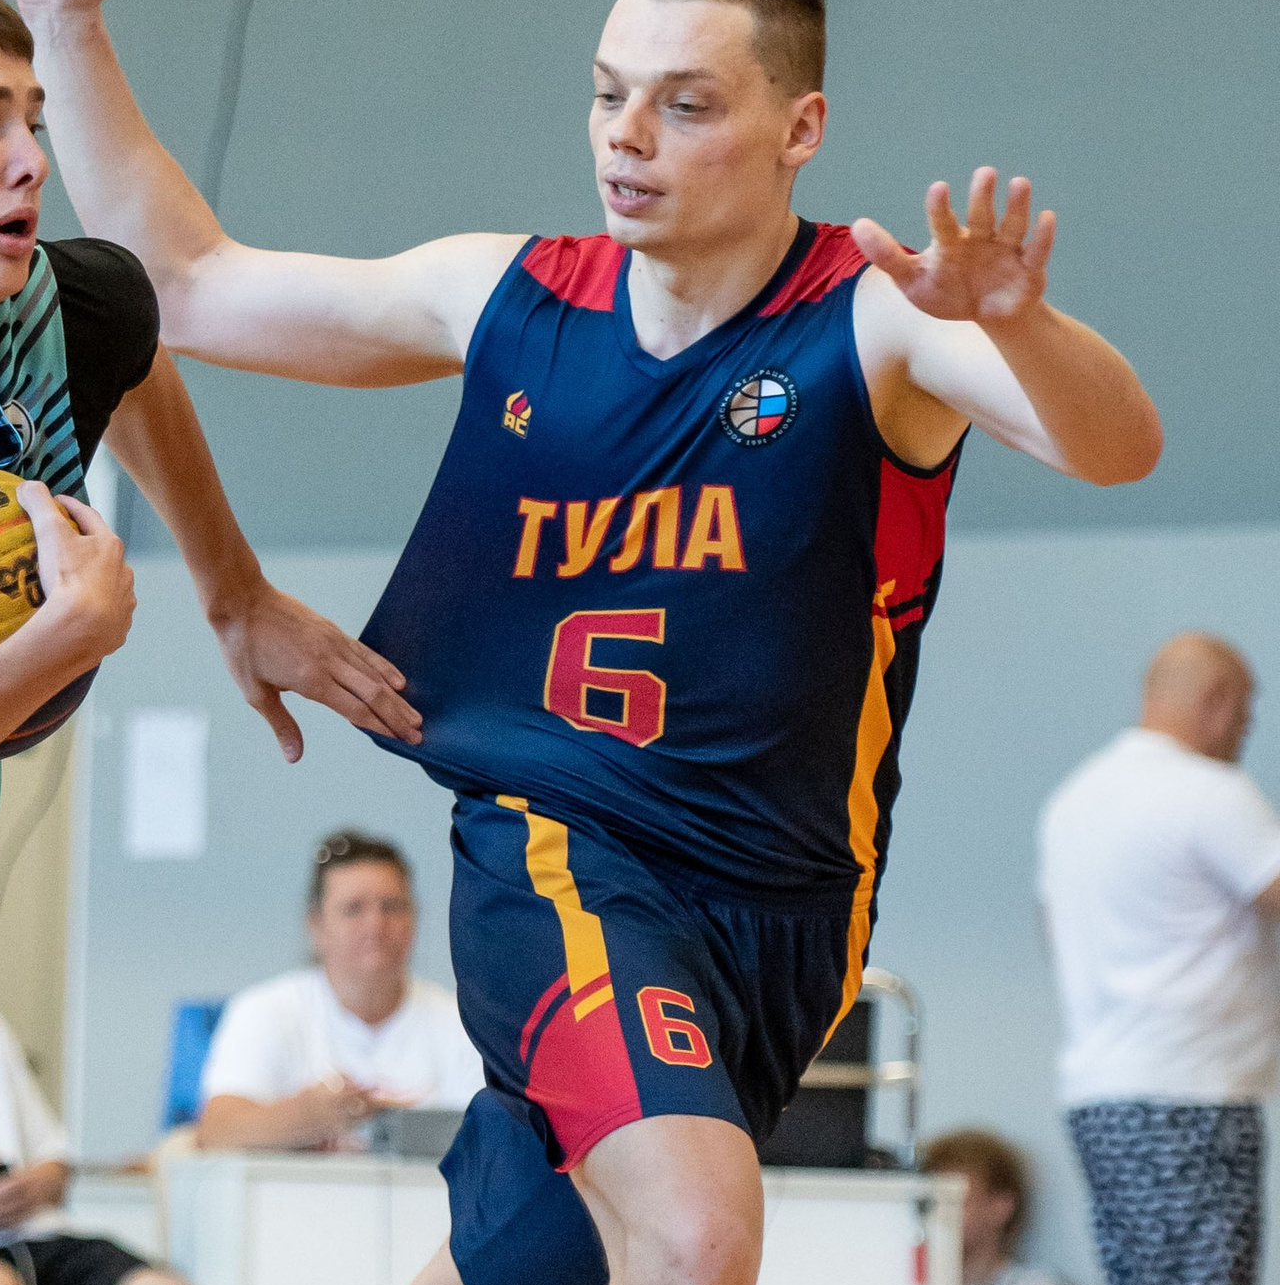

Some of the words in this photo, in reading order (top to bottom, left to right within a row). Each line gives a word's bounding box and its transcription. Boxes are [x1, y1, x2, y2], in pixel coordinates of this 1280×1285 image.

[512, 483, 747, 579] ТУЛА
[544, 608, 666, 747] 6
[636, 986, 713, 1069] 6
